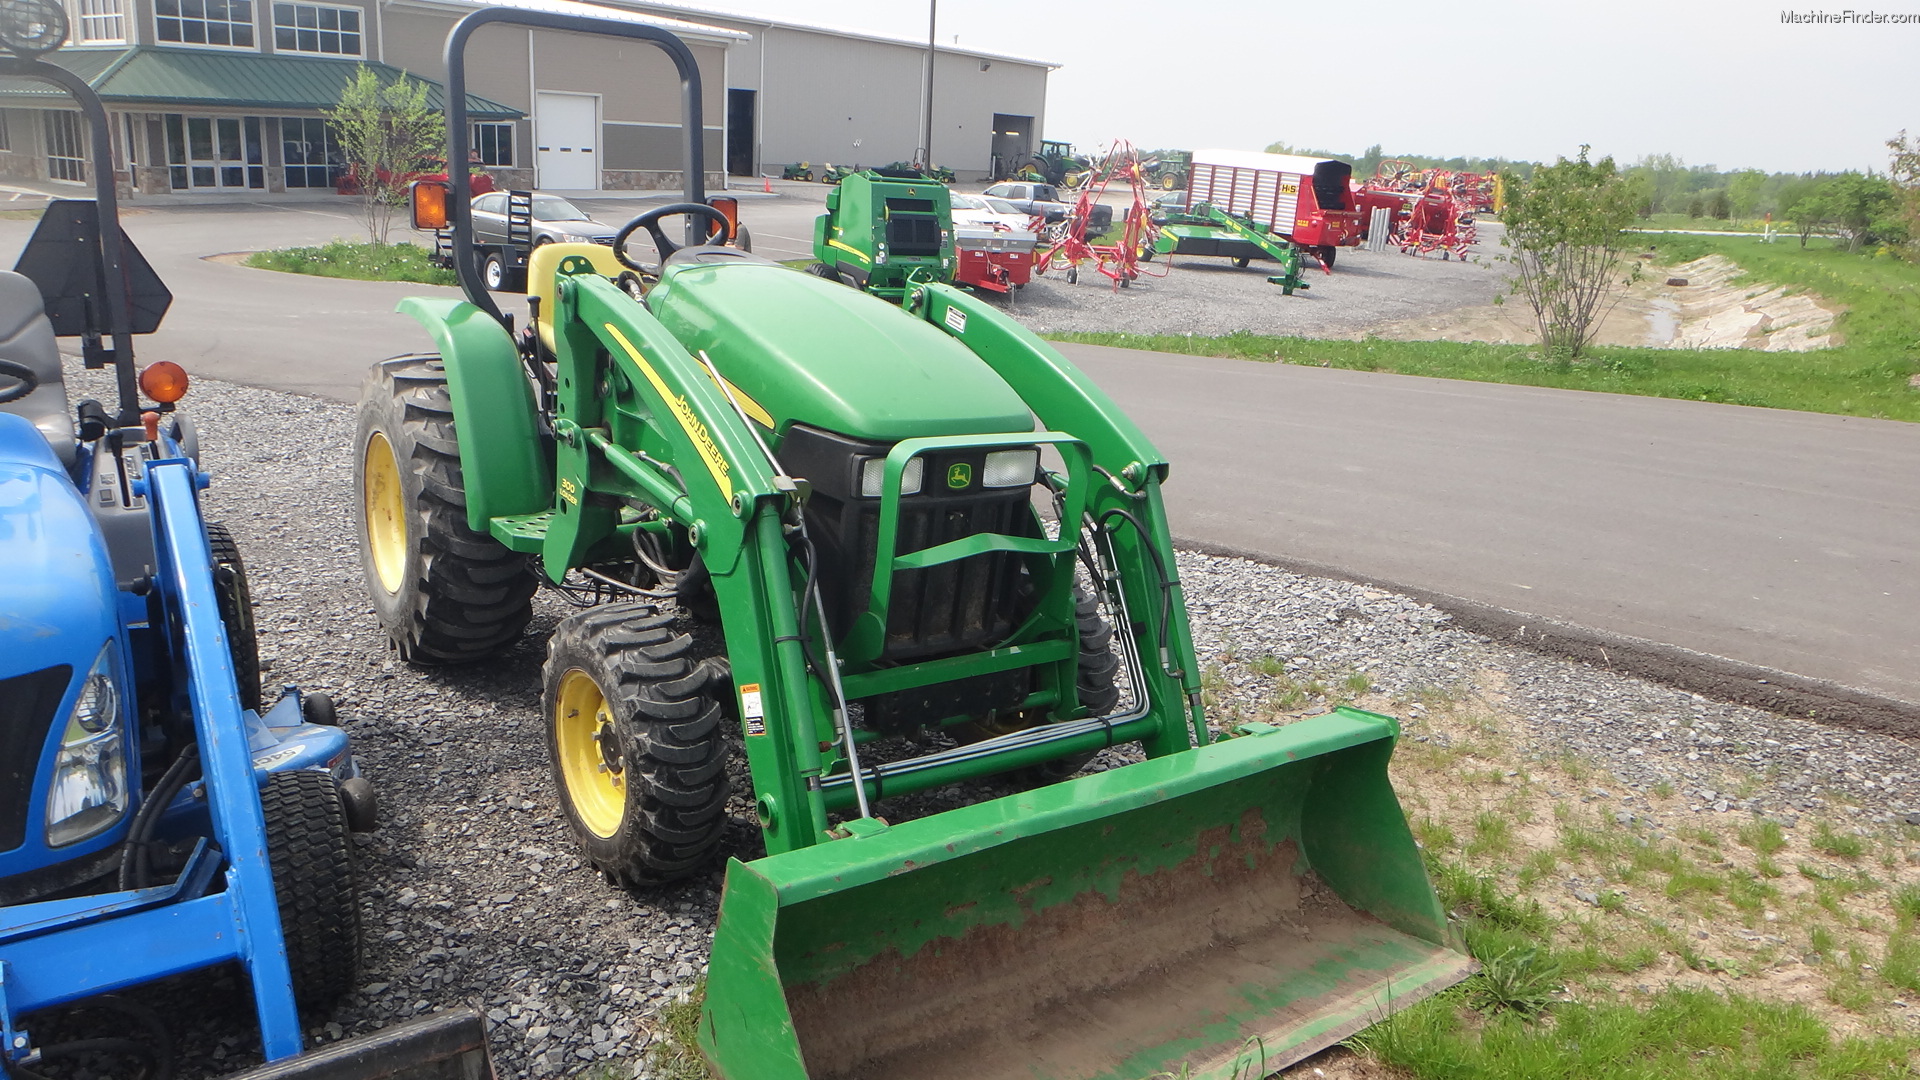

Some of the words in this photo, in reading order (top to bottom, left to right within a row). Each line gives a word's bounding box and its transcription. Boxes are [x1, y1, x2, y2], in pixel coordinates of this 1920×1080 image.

[675, 394, 701, 435] JOHN
[697, 423, 730, 479] DEERE
[561, 477, 576, 494] 300
[559, 487, 578, 506] LOADER
